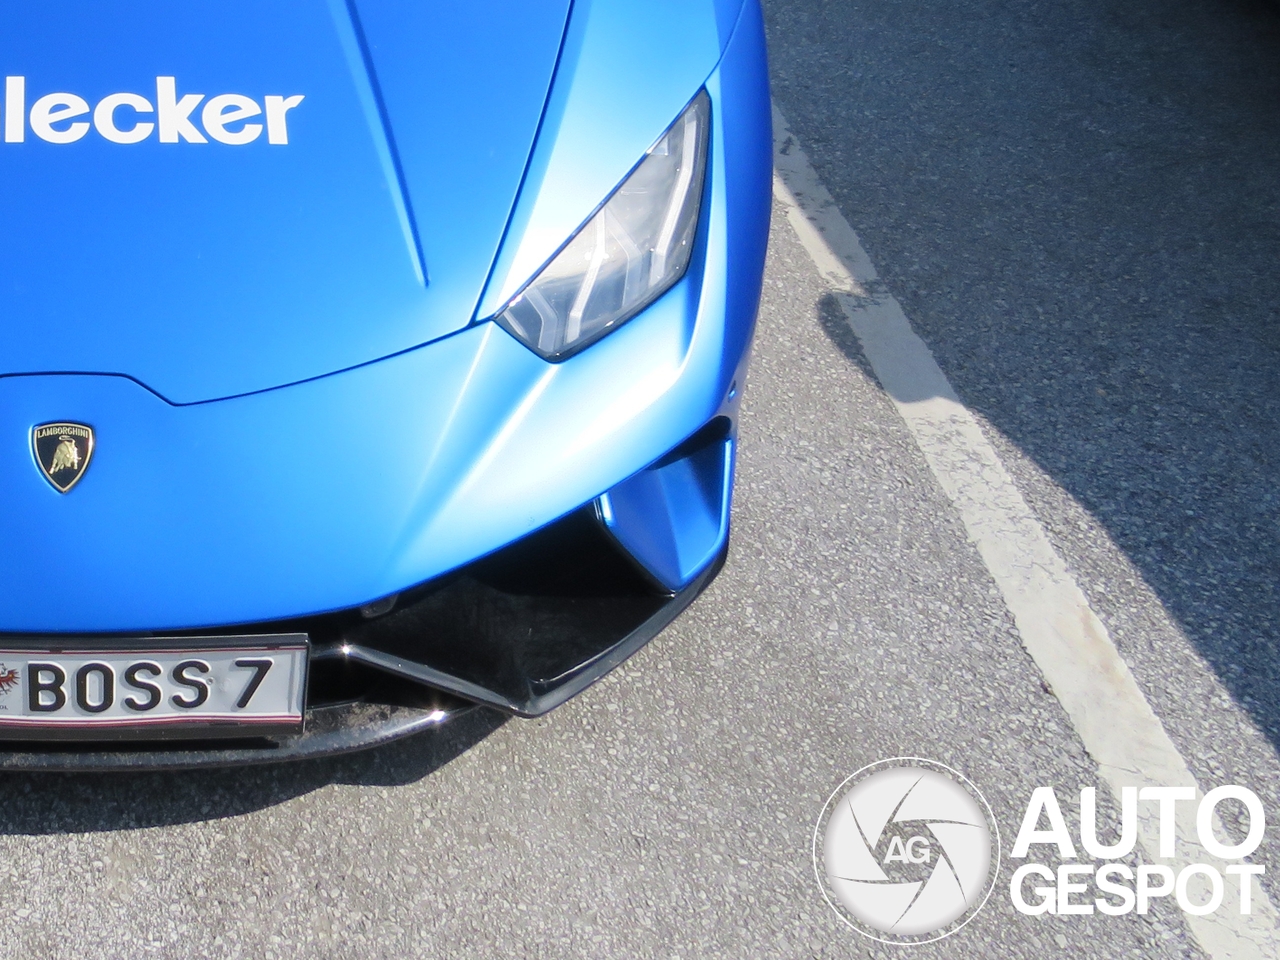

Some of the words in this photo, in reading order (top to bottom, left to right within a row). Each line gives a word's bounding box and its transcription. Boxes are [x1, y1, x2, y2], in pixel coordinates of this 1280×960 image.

[37, 426, 89, 439] LAMBORGHINI
[28, 659, 210, 713] BOSS
[234, 658, 274, 708] 7
